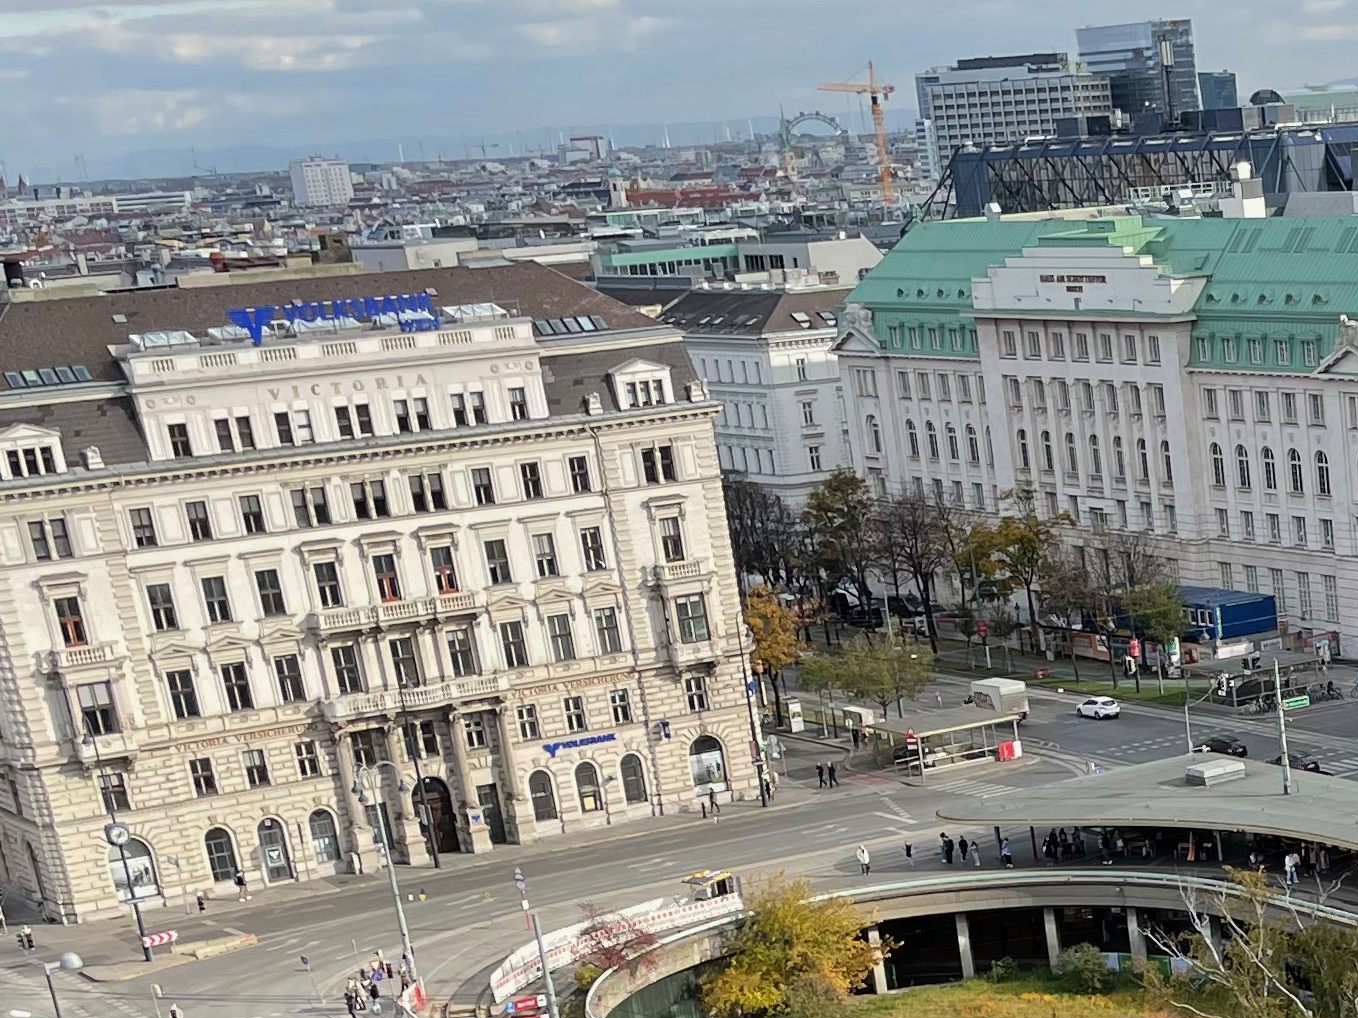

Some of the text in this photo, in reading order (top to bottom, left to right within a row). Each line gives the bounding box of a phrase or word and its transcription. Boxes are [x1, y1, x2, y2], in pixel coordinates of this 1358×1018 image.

[267, 373, 428, 400] VICTORIA
[512, 684, 559, 698] VICTORIA
[175, 738, 229, 752] VICTORIA
